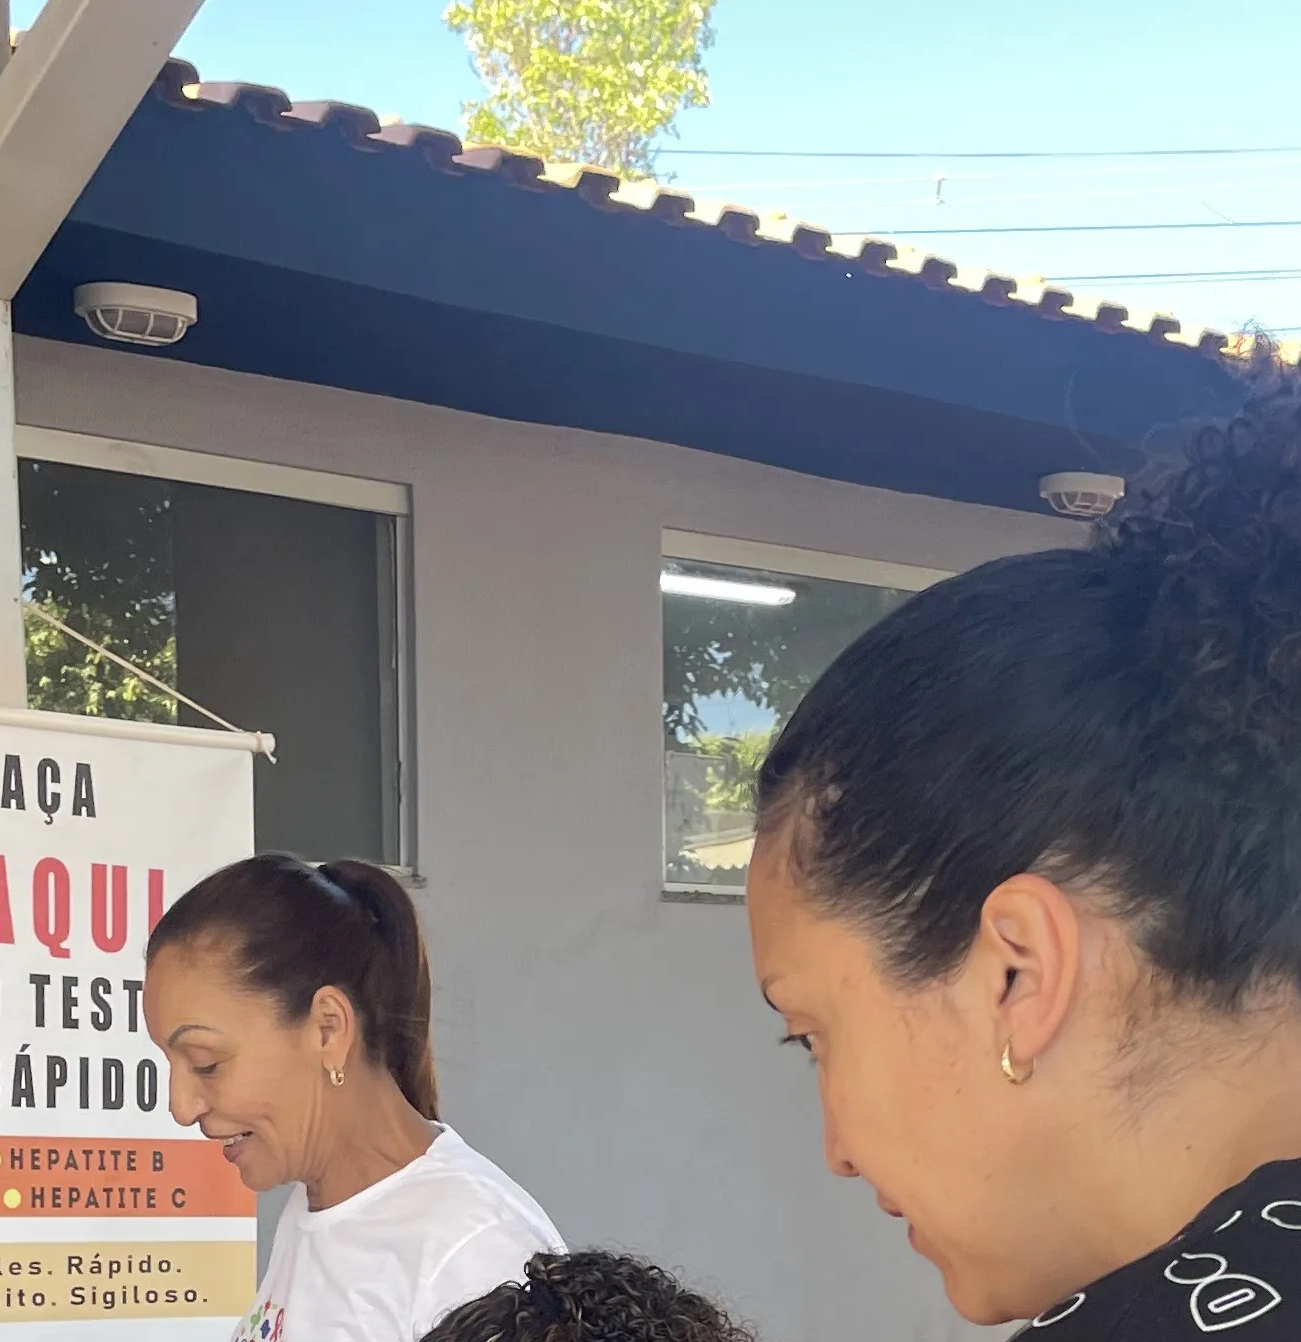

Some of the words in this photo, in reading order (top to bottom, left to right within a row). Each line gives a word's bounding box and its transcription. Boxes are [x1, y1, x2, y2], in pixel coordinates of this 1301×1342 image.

[29, 973, 143, 1033] TEST
[10, 1148, 137, 1171] HEPATITE
[152, 1150, 165, 1172] B
[31, 1187, 157, 1209] HEPATITE
[171, 1188, 187, 1209] C
[67, 1252, 182, 1279] Rápido.
[70, 1285, 208, 1310] Sigiloso.
